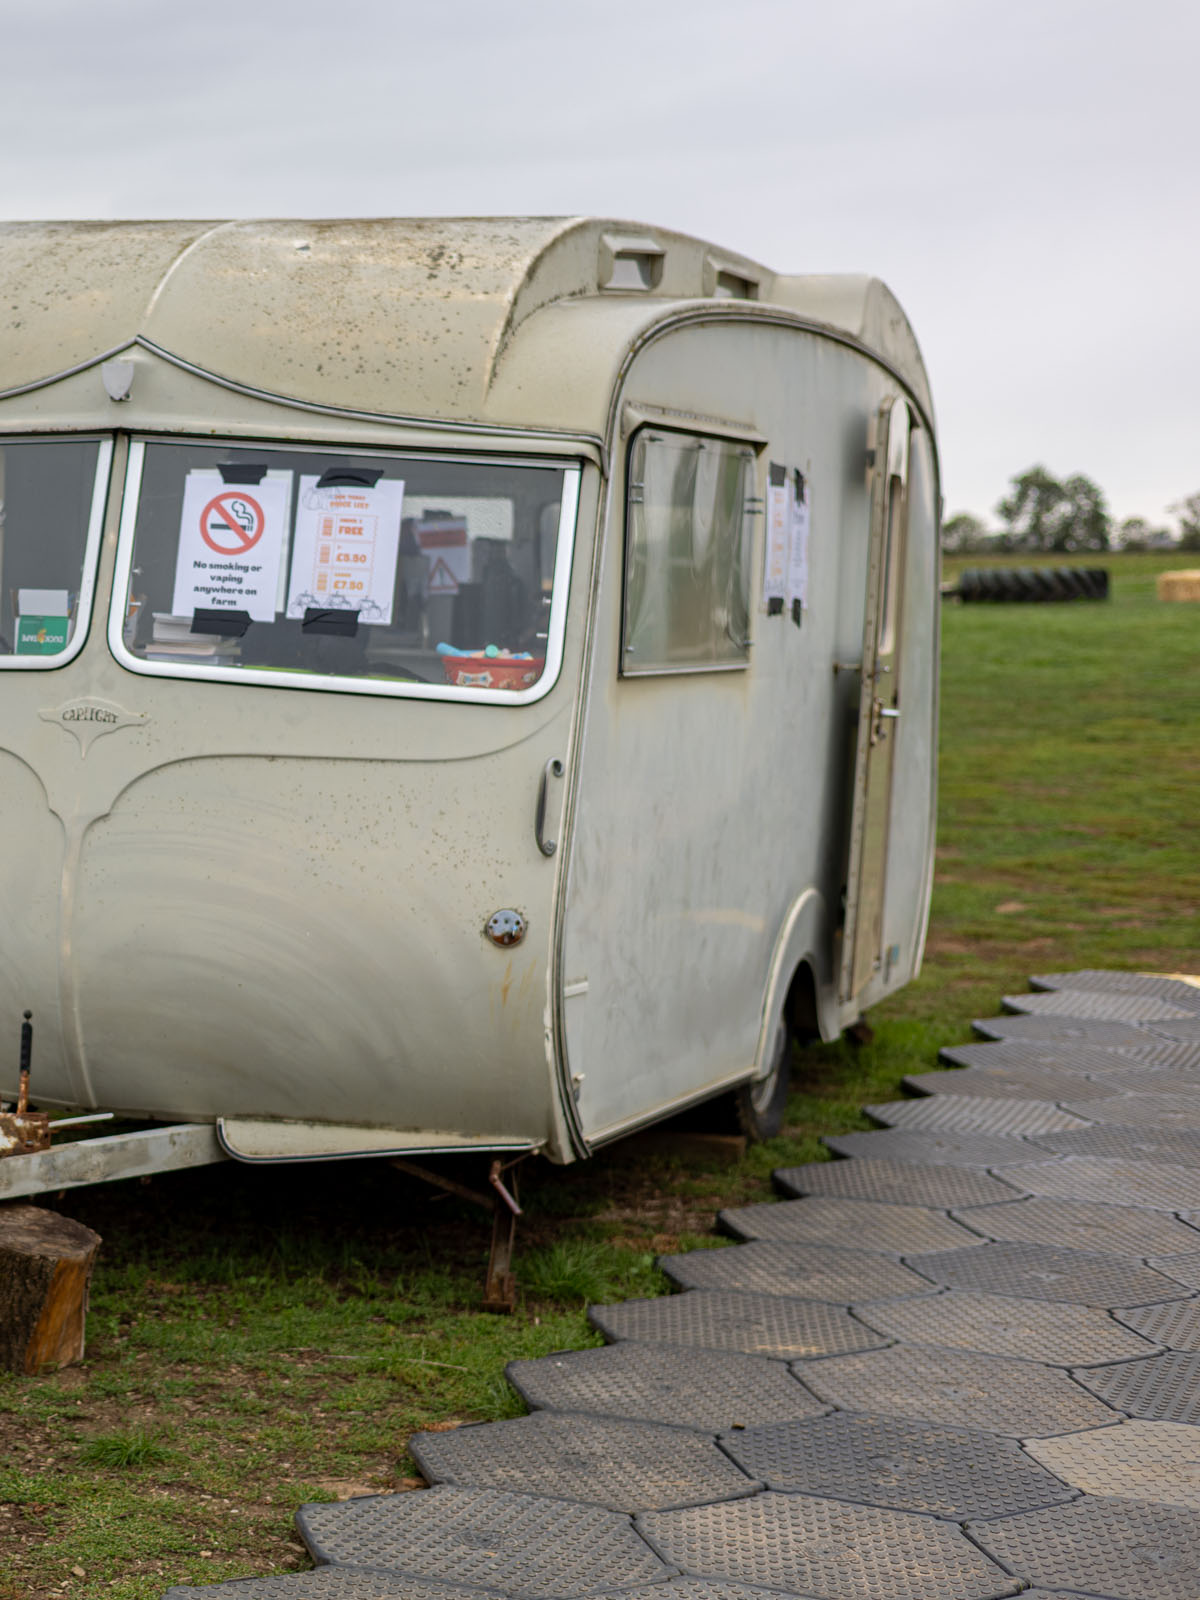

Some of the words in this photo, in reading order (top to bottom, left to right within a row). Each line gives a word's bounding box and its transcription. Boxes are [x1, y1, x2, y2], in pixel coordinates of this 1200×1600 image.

[338, 526, 363, 536] FREE
[193, 560, 207, 569] No
[208, 562, 249, 573] smoking
[210, 574, 243, 584] vaping
[193, 585, 243, 594] anywhere
[211, 597, 237, 606] farm
